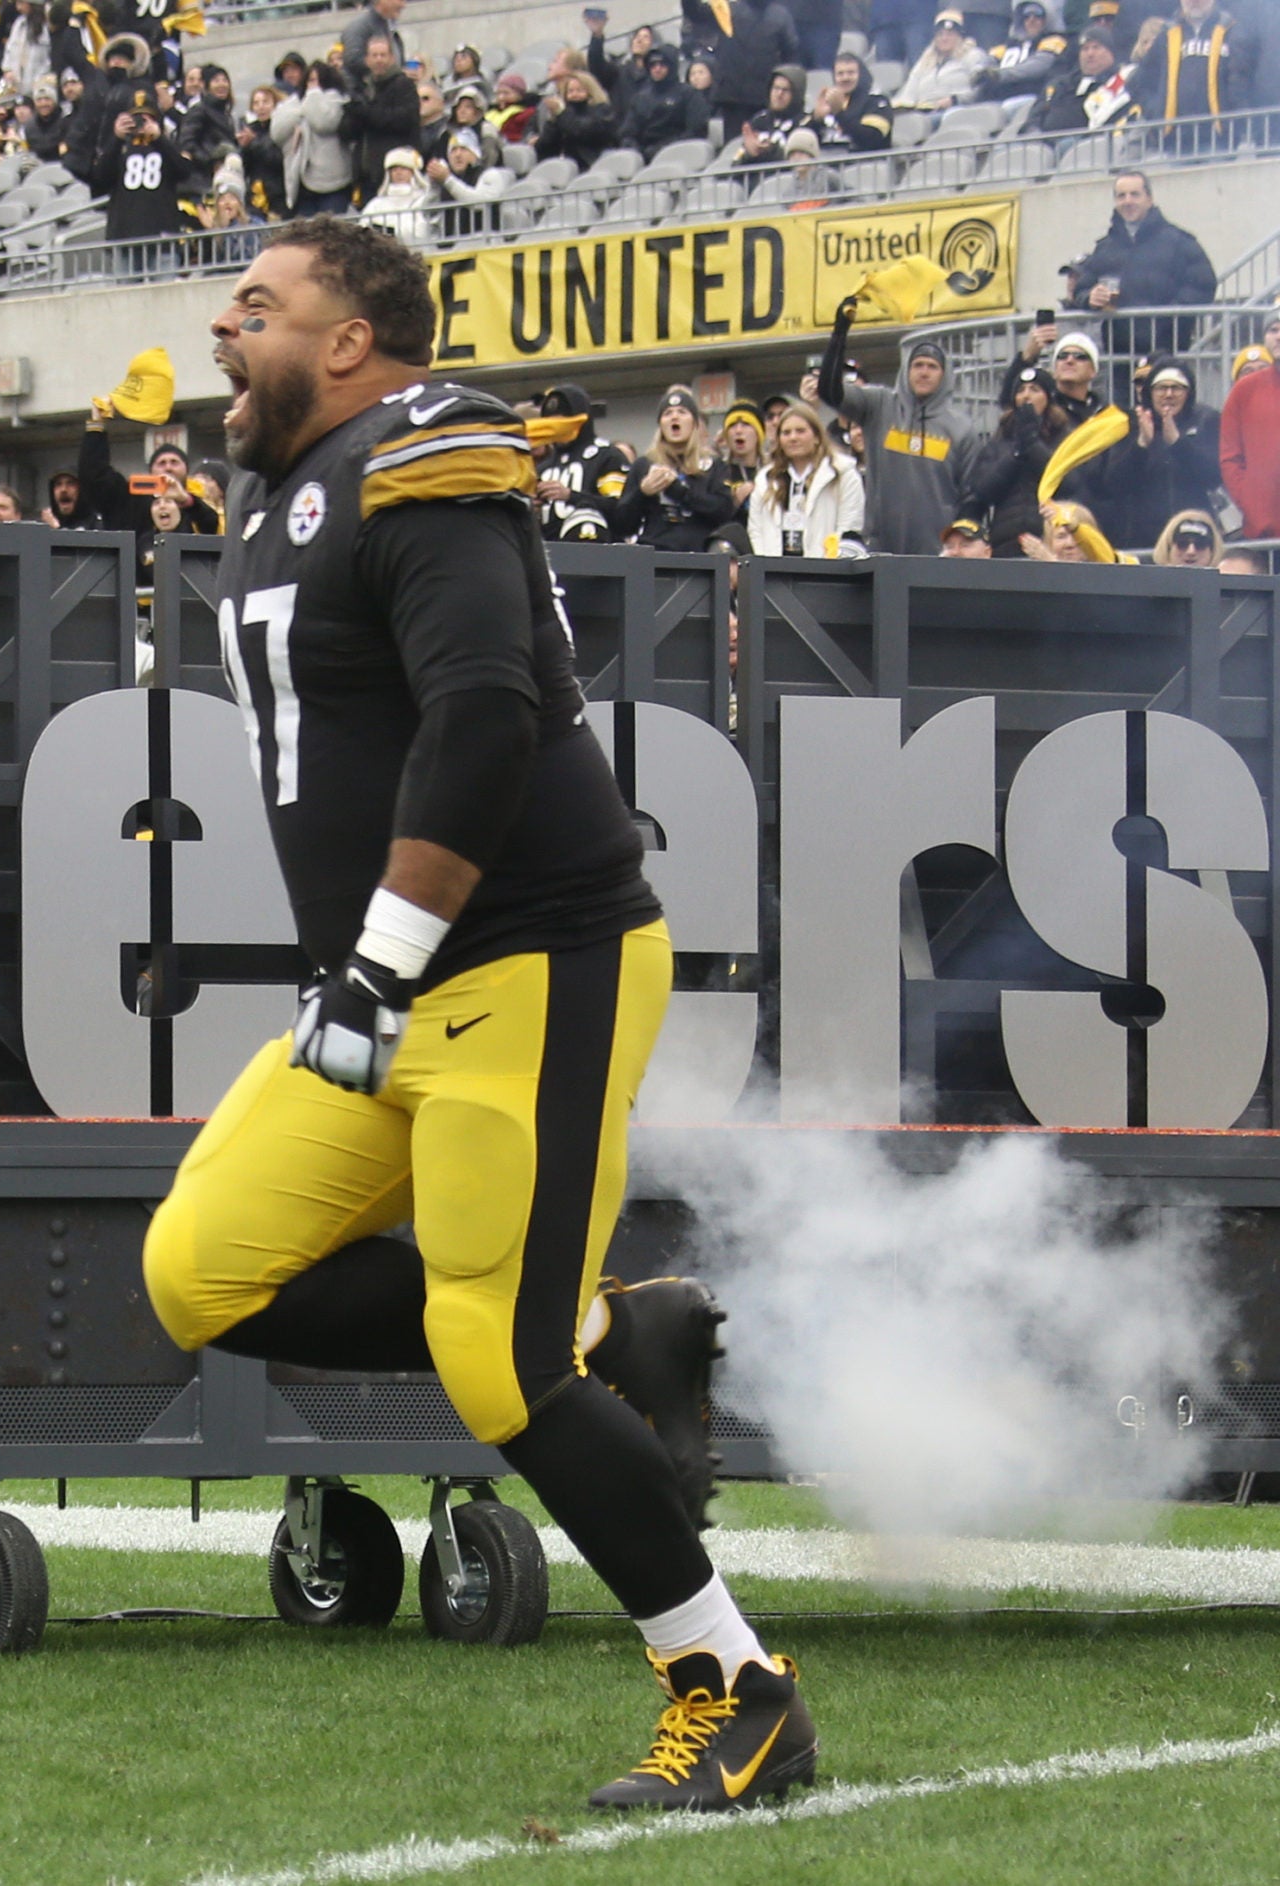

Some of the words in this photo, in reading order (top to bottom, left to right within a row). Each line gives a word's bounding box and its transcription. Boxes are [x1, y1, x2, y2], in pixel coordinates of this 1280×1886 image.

[123, 152, 163, 190] 88
[823, 223, 921, 266] United
[511, 225, 785, 354] UNITED
